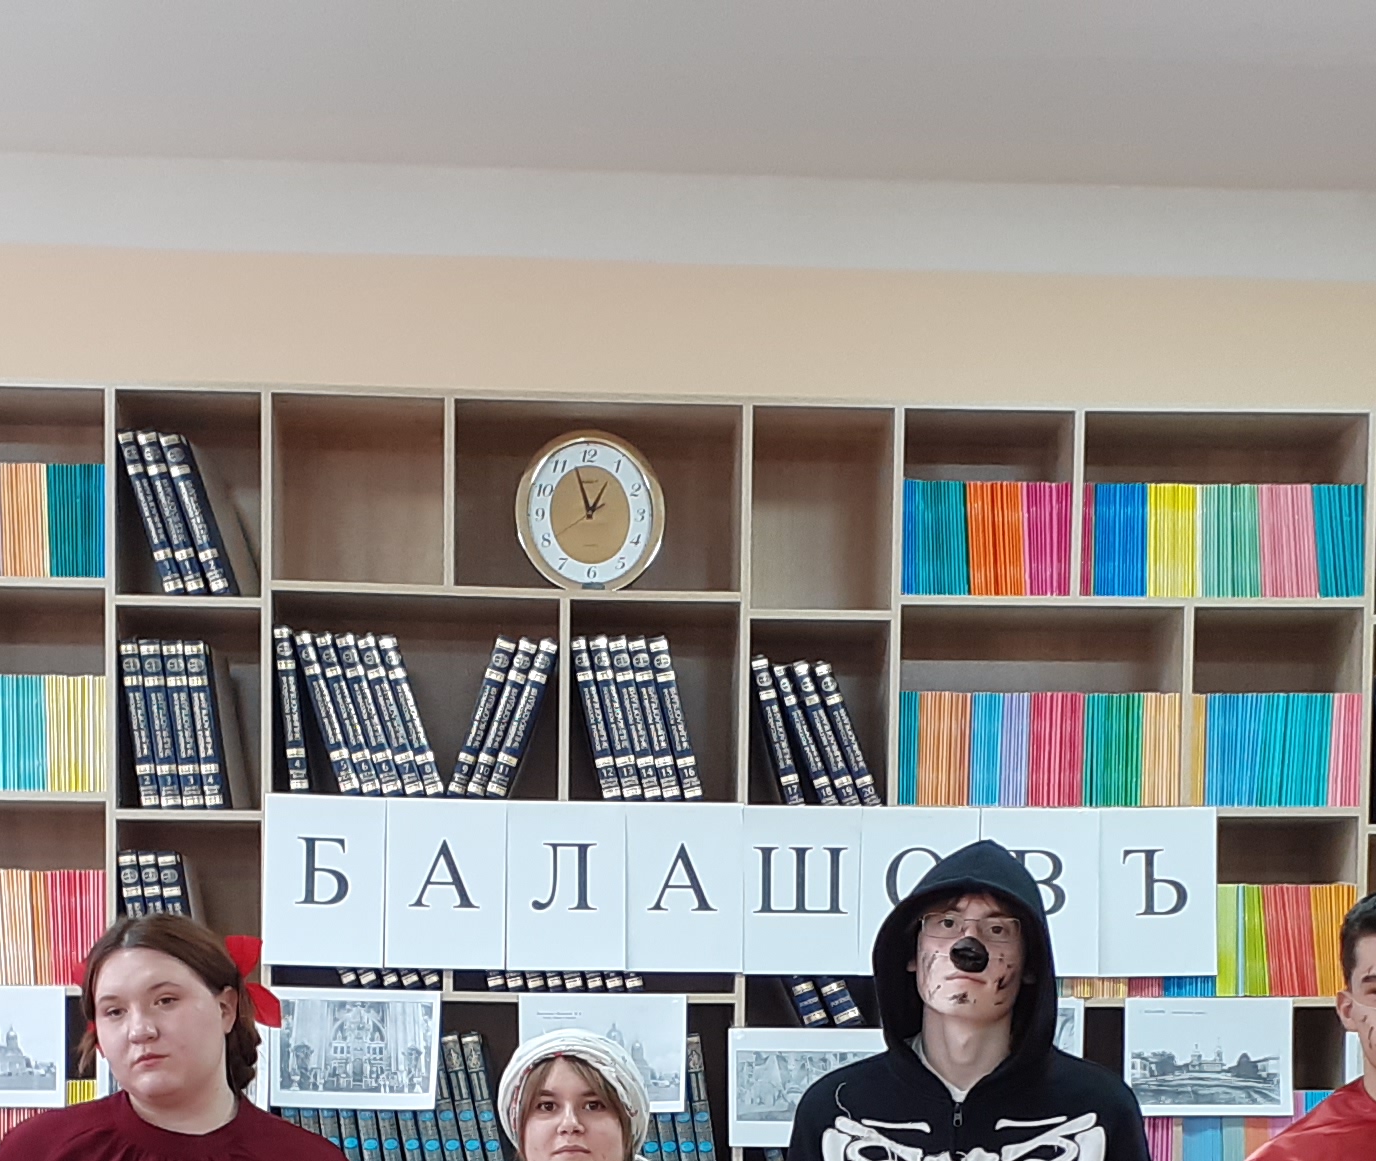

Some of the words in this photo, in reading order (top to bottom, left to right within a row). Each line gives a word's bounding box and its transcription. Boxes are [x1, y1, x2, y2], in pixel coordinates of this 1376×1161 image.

[580, 448, 598, 463] 12
[552, 459, 568, 474] 11
[614, 459, 622, 473] 1
[535, 483, 554, 498] 10
[630, 482, 642, 497] 2
[535, 507, 546, 521] 9
[634, 508, 646, 522] 3
[541, 533, 552, 548] 8
[629, 534, 642, 548] 4
[558, 557, 569, 572] 7
[615, 557, 626, 570] 5
[586, 565, 597, 579] 6
[294, 760, 301, 769] 4
[360, 761, 369, 772] 6
[381, 762, 389, 772] 6
[402, 763, 410, 774] 7
[424, 763, 432, 774] 8
[461, 764, 469, 775] 9
[479, 766, 490, 776] 10
[498, 765, 510, 776] 11
[602, 767, 615, 778] 12
[622, 767, 634, 777] 13
[641, 767, 654, 778] 14
[661, 767, 673, 777] 15
[683, 767, 695, 777] 16
[787, 785, 798, 796] 17
[821, 787, 833, 796] 18
[841, 786, 854, 797] 19
[862, 785, 875, 798] 20
